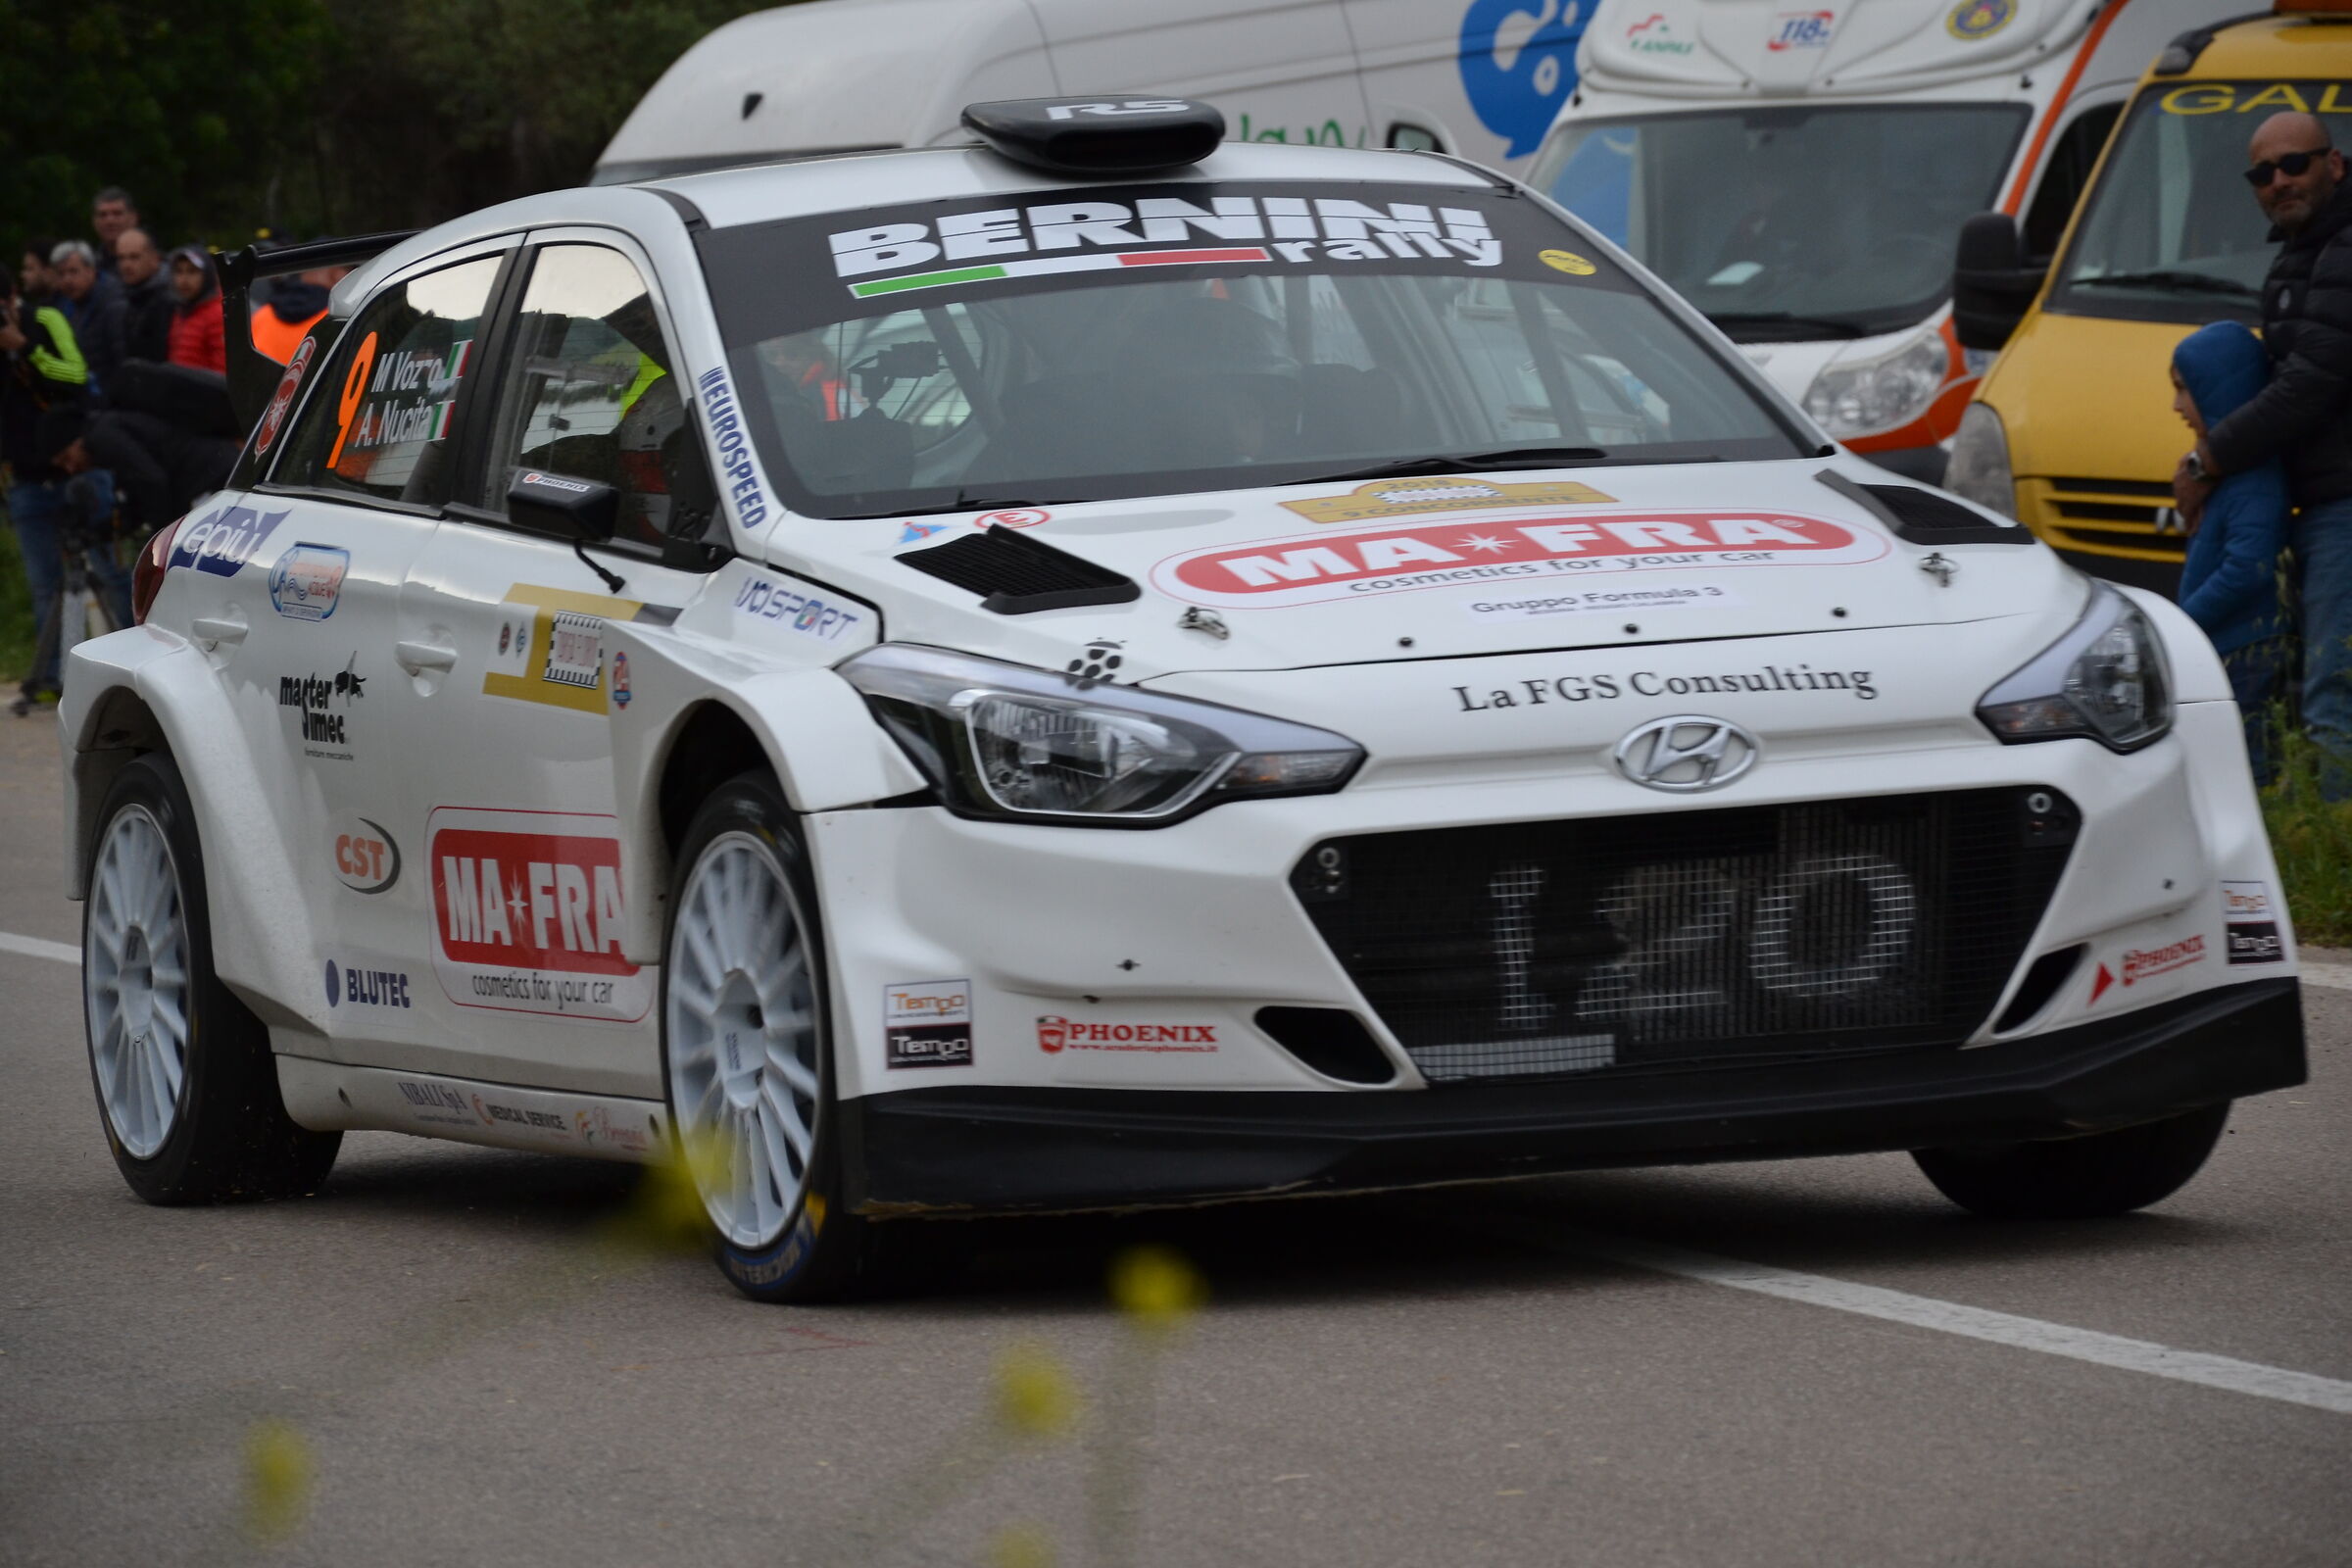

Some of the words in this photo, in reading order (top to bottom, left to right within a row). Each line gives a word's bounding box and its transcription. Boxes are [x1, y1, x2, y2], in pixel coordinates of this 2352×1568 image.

[828, 197, 1494, 277] BERNINI
[1274, 230, 1502, 267] rally
[326, 331, 377, 468] 9
[375, 396, 433, 445] Nucita
[701, 374, 768, 529] EUROSPEED
[1348, 563, 1540, 593] cosmetics
[1549, 556, 1602, 571] for
[1617, 552, 1703, 569] your
[1717, 550, 1775, 563] car
[1471, 596, 1579, 613] Gruppo
[1583, 588, 1700, 604] Formula
[1703, 587, 1725, 597] 3
[1452, 686, 1517, 712] La
[1521, 674, 1623, 705] FGS
[1629, 663, 1879, 701] Consulting
[335, 834, 385, 881] CST
[442, 856, 514, 947] MA
[346, 968, 411, 1008] BLUTEC
[472, 970, 530, 1000] cosmetics
[532, 972, 552, 1001] for
[555, 980, 587, 1010] your
[592, 981, 613, 1004] car
[890, 1036, 969, 1059] Tempo
[1068, 1023, 1217, 1043] PHOENIX
